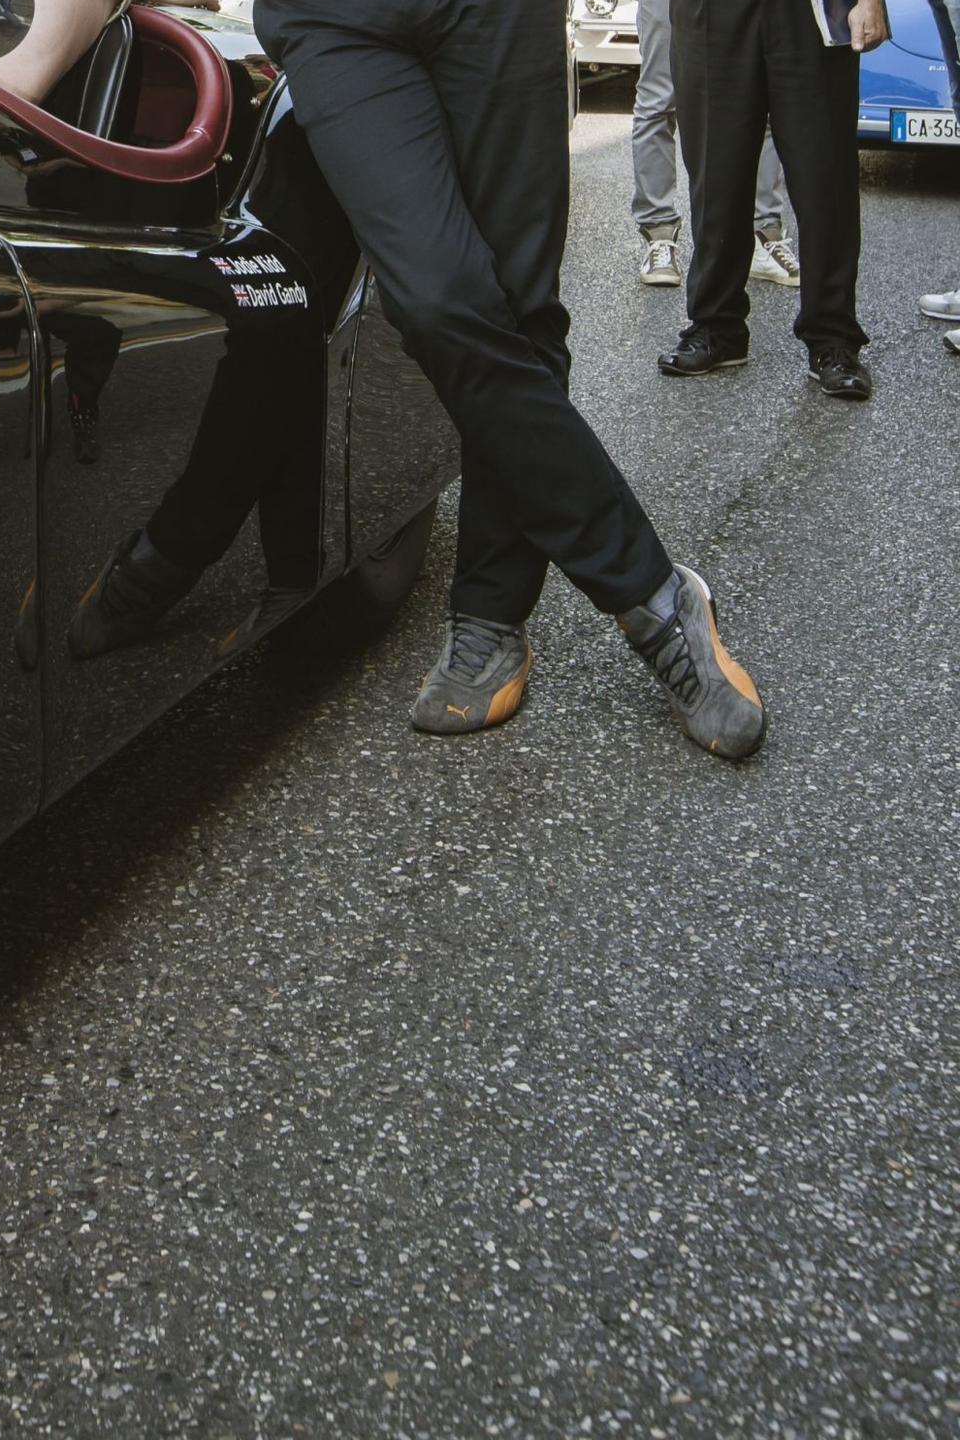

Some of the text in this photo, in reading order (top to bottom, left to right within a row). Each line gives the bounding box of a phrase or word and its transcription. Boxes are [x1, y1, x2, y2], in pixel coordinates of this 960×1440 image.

[252, 254, 286, 274] Kidd
[245, 280, 308, 309] David Gandy
